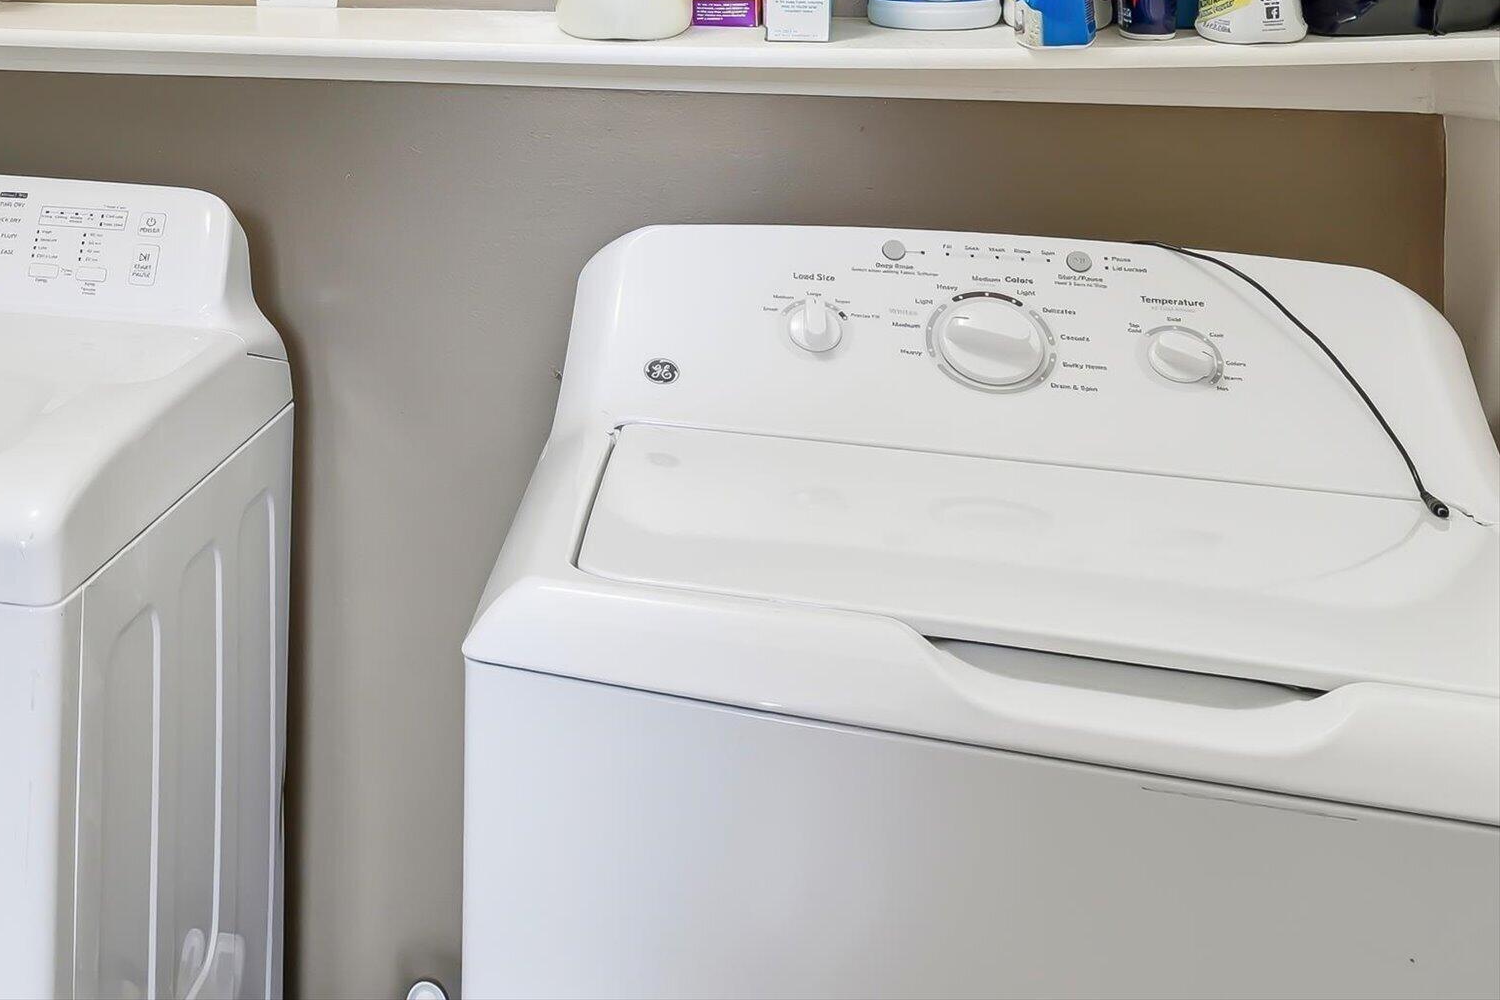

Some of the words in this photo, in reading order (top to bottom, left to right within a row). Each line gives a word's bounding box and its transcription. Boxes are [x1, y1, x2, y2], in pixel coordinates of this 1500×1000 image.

[793, 272, 814, 281] Load
[817, 273, 835, 282] Size
[1004, 276, 1034, 284] Colors
[1140, 296, 1205, 308] Temperature
[1042, 307, 1077, 315] Delicates
